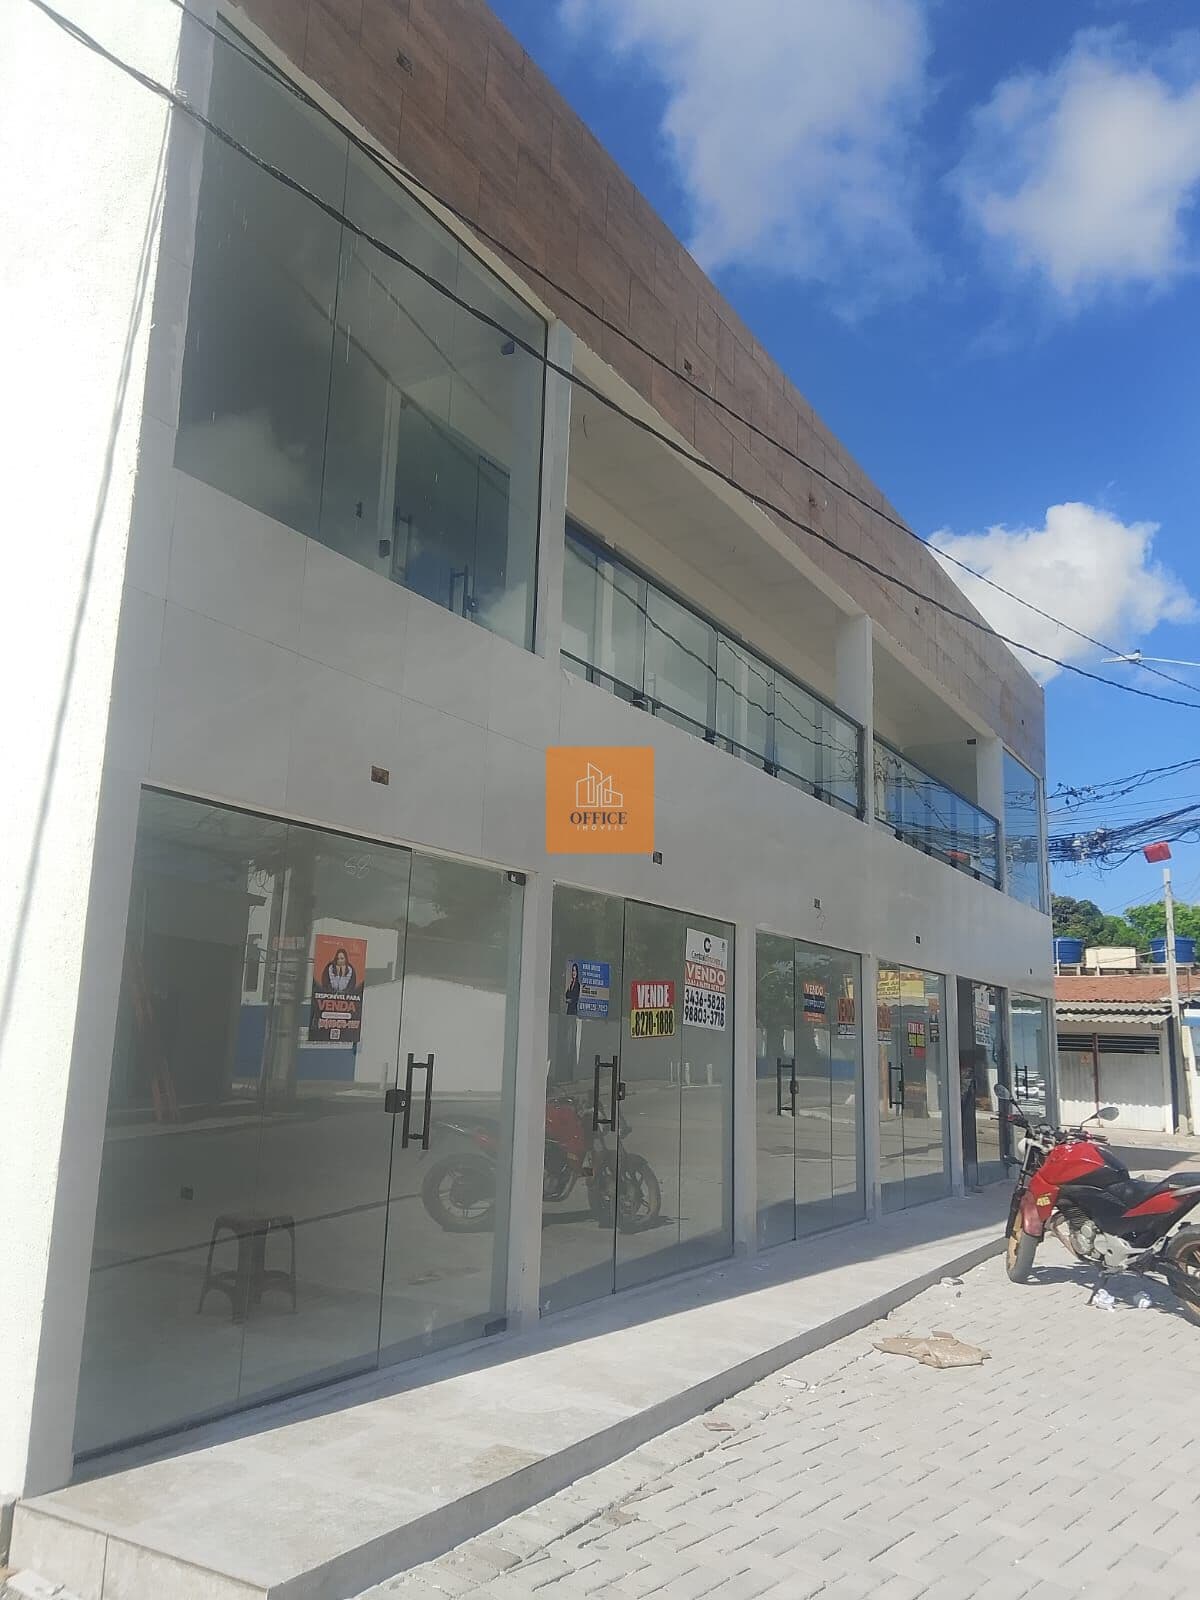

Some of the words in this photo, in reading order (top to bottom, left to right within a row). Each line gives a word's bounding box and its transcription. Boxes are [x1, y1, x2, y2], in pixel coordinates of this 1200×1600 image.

[686, 962, 726, 986] VENDO
[317, 999, 357, 1012] VENDA
[636, 984, 670, 1008] VENDE
[685, 989, 725, 1012] 3436-5828
[684, 1005, 725, 1028] 98803-3718
